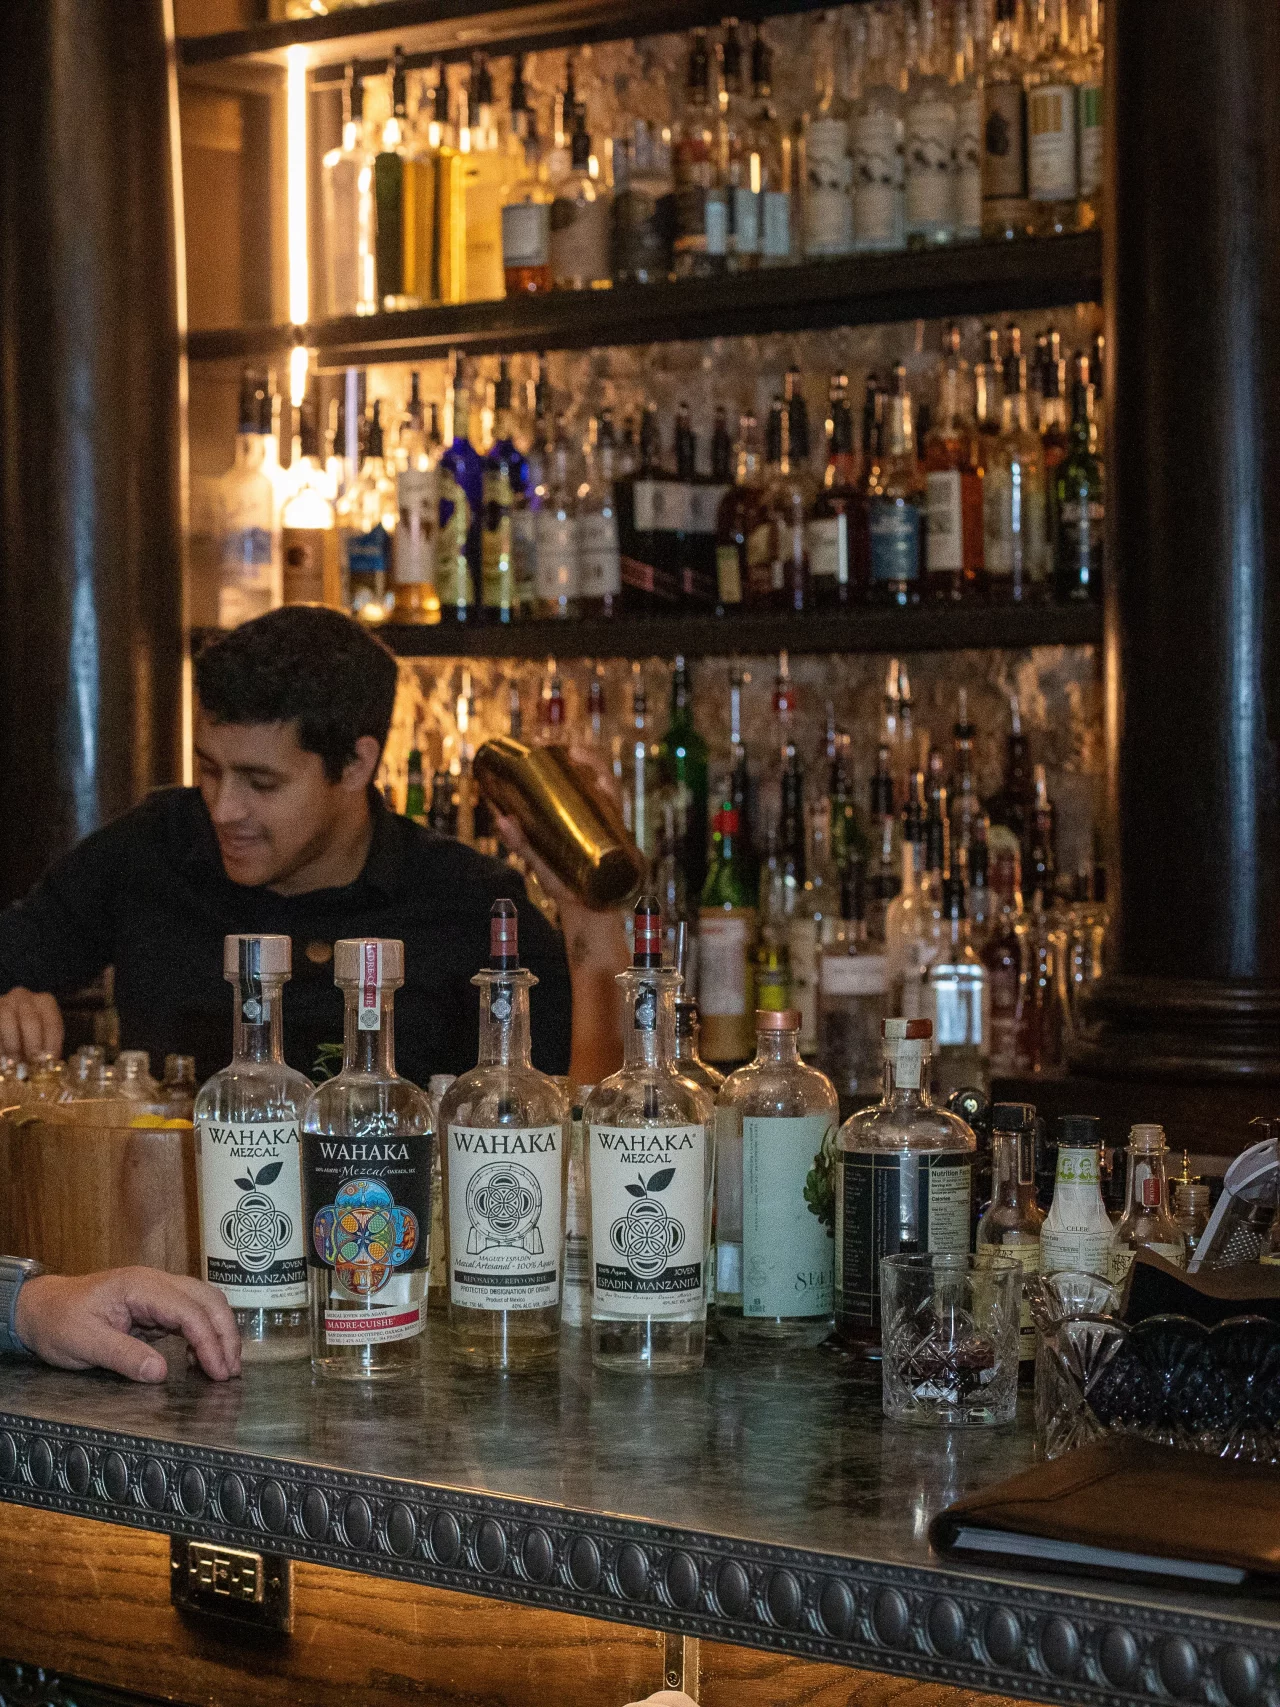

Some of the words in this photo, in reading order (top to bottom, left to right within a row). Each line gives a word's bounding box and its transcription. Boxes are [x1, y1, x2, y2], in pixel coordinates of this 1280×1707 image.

[208, 1128, 300, 1146] WAHAKA
[598, 1133, 694, 1152] WAHAKA
[453, 1132, 556, 1155] WAHAKA
[230, 1147, 280, 1159] MEZCAL
[320, 1142, 410, 1161] WAHAKA
[620, 1153, 672, 1164] MEZCAL
[339, 1164, 389, 1178] Mezcal
[931, 1170, 959, 1178] Nutrition
[282, 1259, 303, 1270] JOVEN
[454, 1259, 476, 1269] Mezcal
[475, 1261, 511, 1271] Artesanal
[516, 1261, 537, 1271] 100%
[209, 1270, 242, 1283] ESPADIN
[245, 1270, 307, 1284] MANZANITA
[674, 1266, 696, 1276] JOVEN
[597, 1277, 633, 1290] ESPADIN
[635, 1277, 700, 1291] MANZANITA
[460, 1285, 489, 1295] PROTECTED
[489, 1288, 527, 1296] DESIGNATION
[327, 1318, 394, 1329] MADRE-CUISHE
